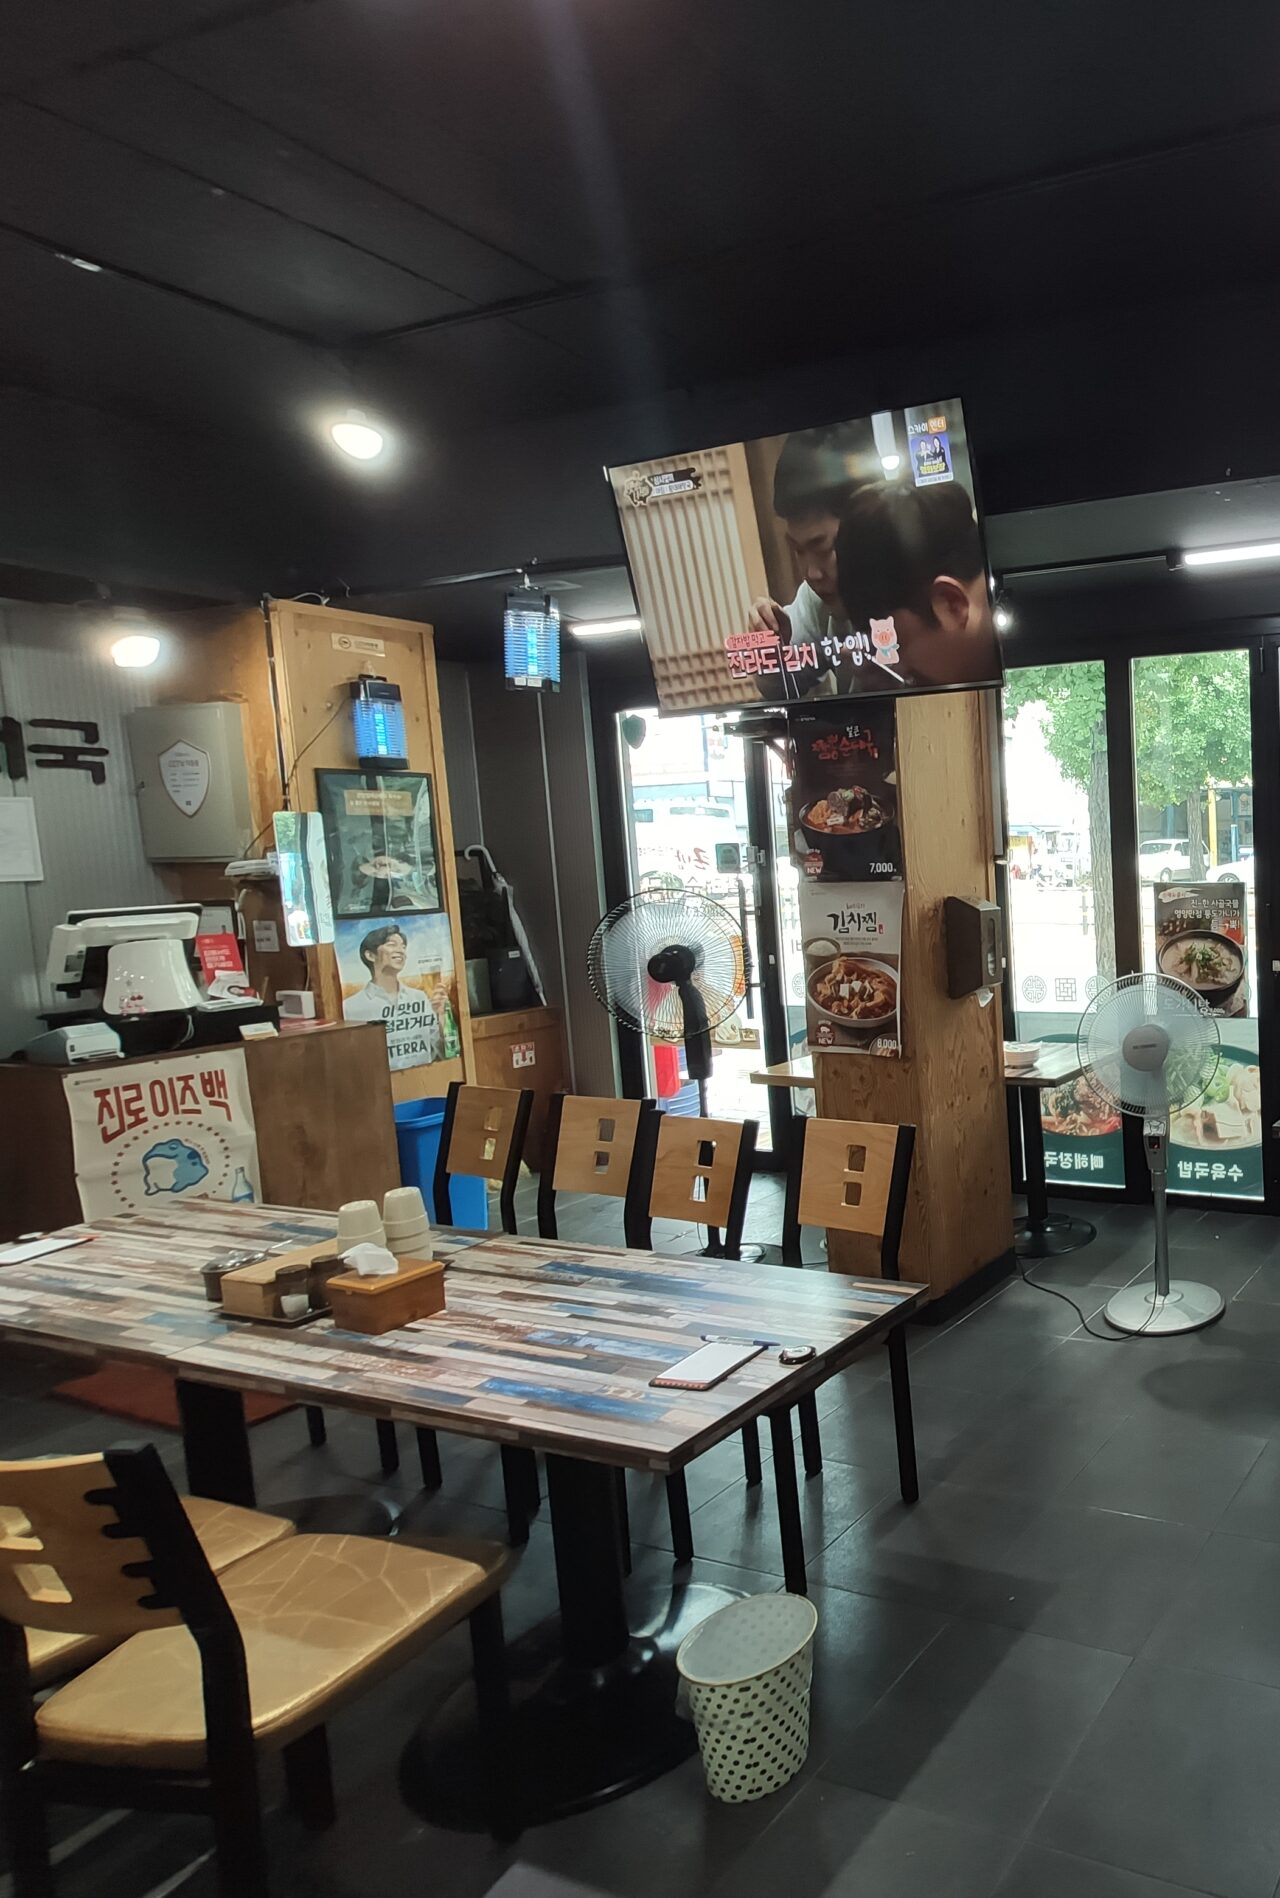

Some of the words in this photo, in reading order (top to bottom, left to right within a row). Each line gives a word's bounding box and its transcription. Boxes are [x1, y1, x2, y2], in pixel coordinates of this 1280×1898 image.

[727, 648, 781, 679] 전라도
[782, 642, 819, 673] 김치
[397, 999, 426, 1017] 맛이
[387, 1039, 428, 1059] TERRA
